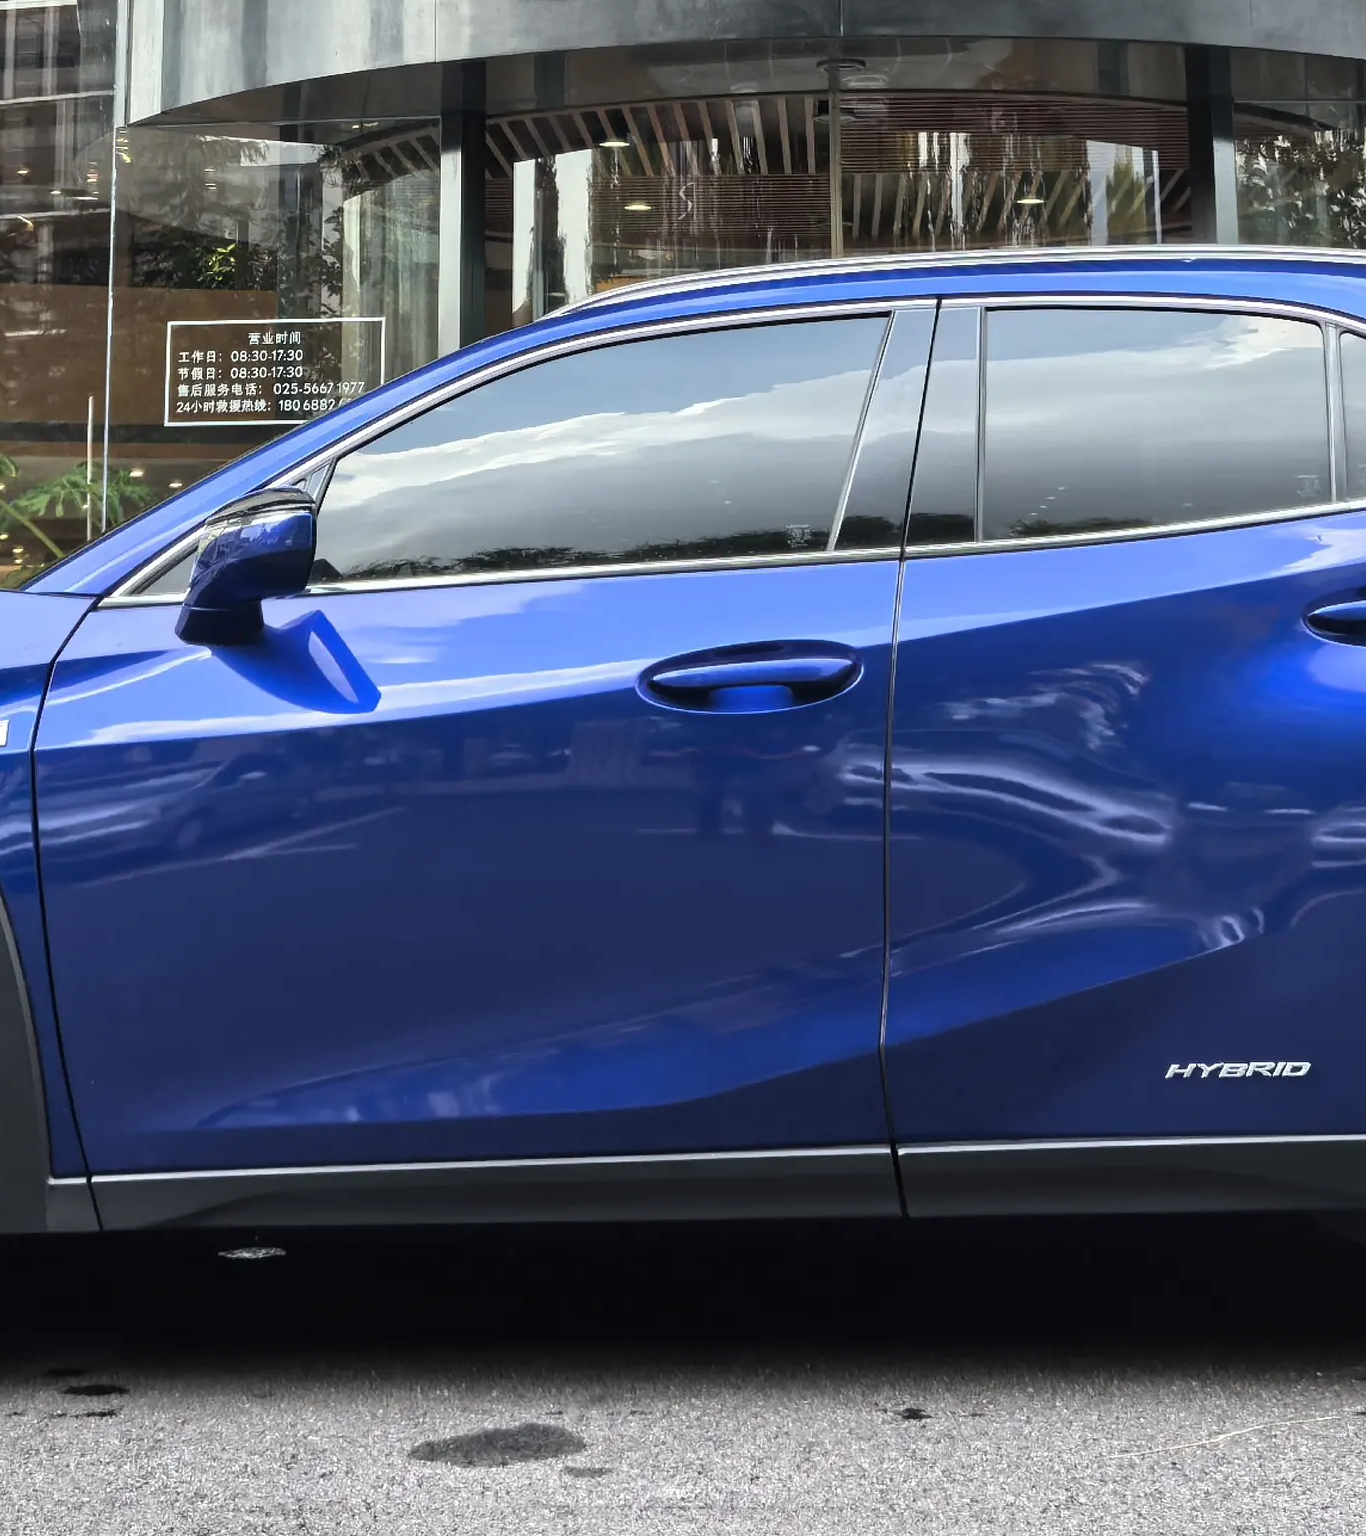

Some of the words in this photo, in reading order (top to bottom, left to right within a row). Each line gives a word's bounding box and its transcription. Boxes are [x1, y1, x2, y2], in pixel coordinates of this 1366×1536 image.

[248, 330, 301, 346] 营业时间
[1164, 1061, 1312, 1079] HYBRID
